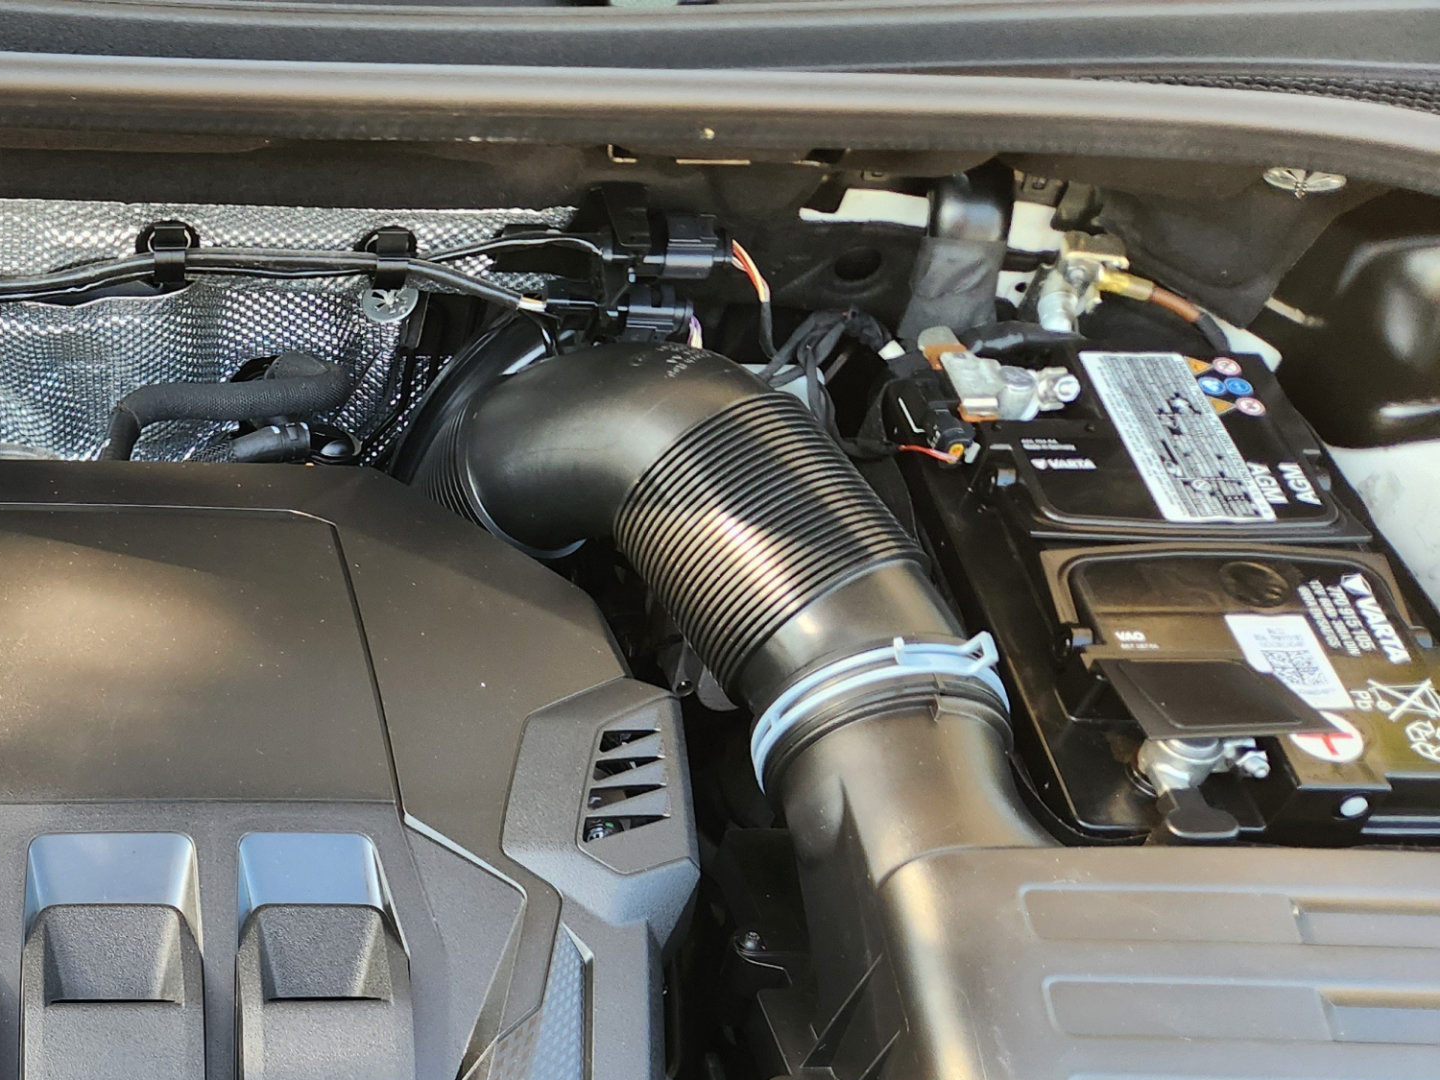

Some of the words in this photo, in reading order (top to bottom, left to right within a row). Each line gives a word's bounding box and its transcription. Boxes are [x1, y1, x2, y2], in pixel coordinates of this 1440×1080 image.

[1047, 458, 1097, 470] VARTA
[1247, 462, 1289, 504] AGM
[1278, 462, 1322, 505] AGM
[1338, 607, 1362, 629] 915
[1351, 629, 1376, 652] 105
[1355, 596, 1411, 665] VARTA
[1349, 690, 1374, 712] Pb
